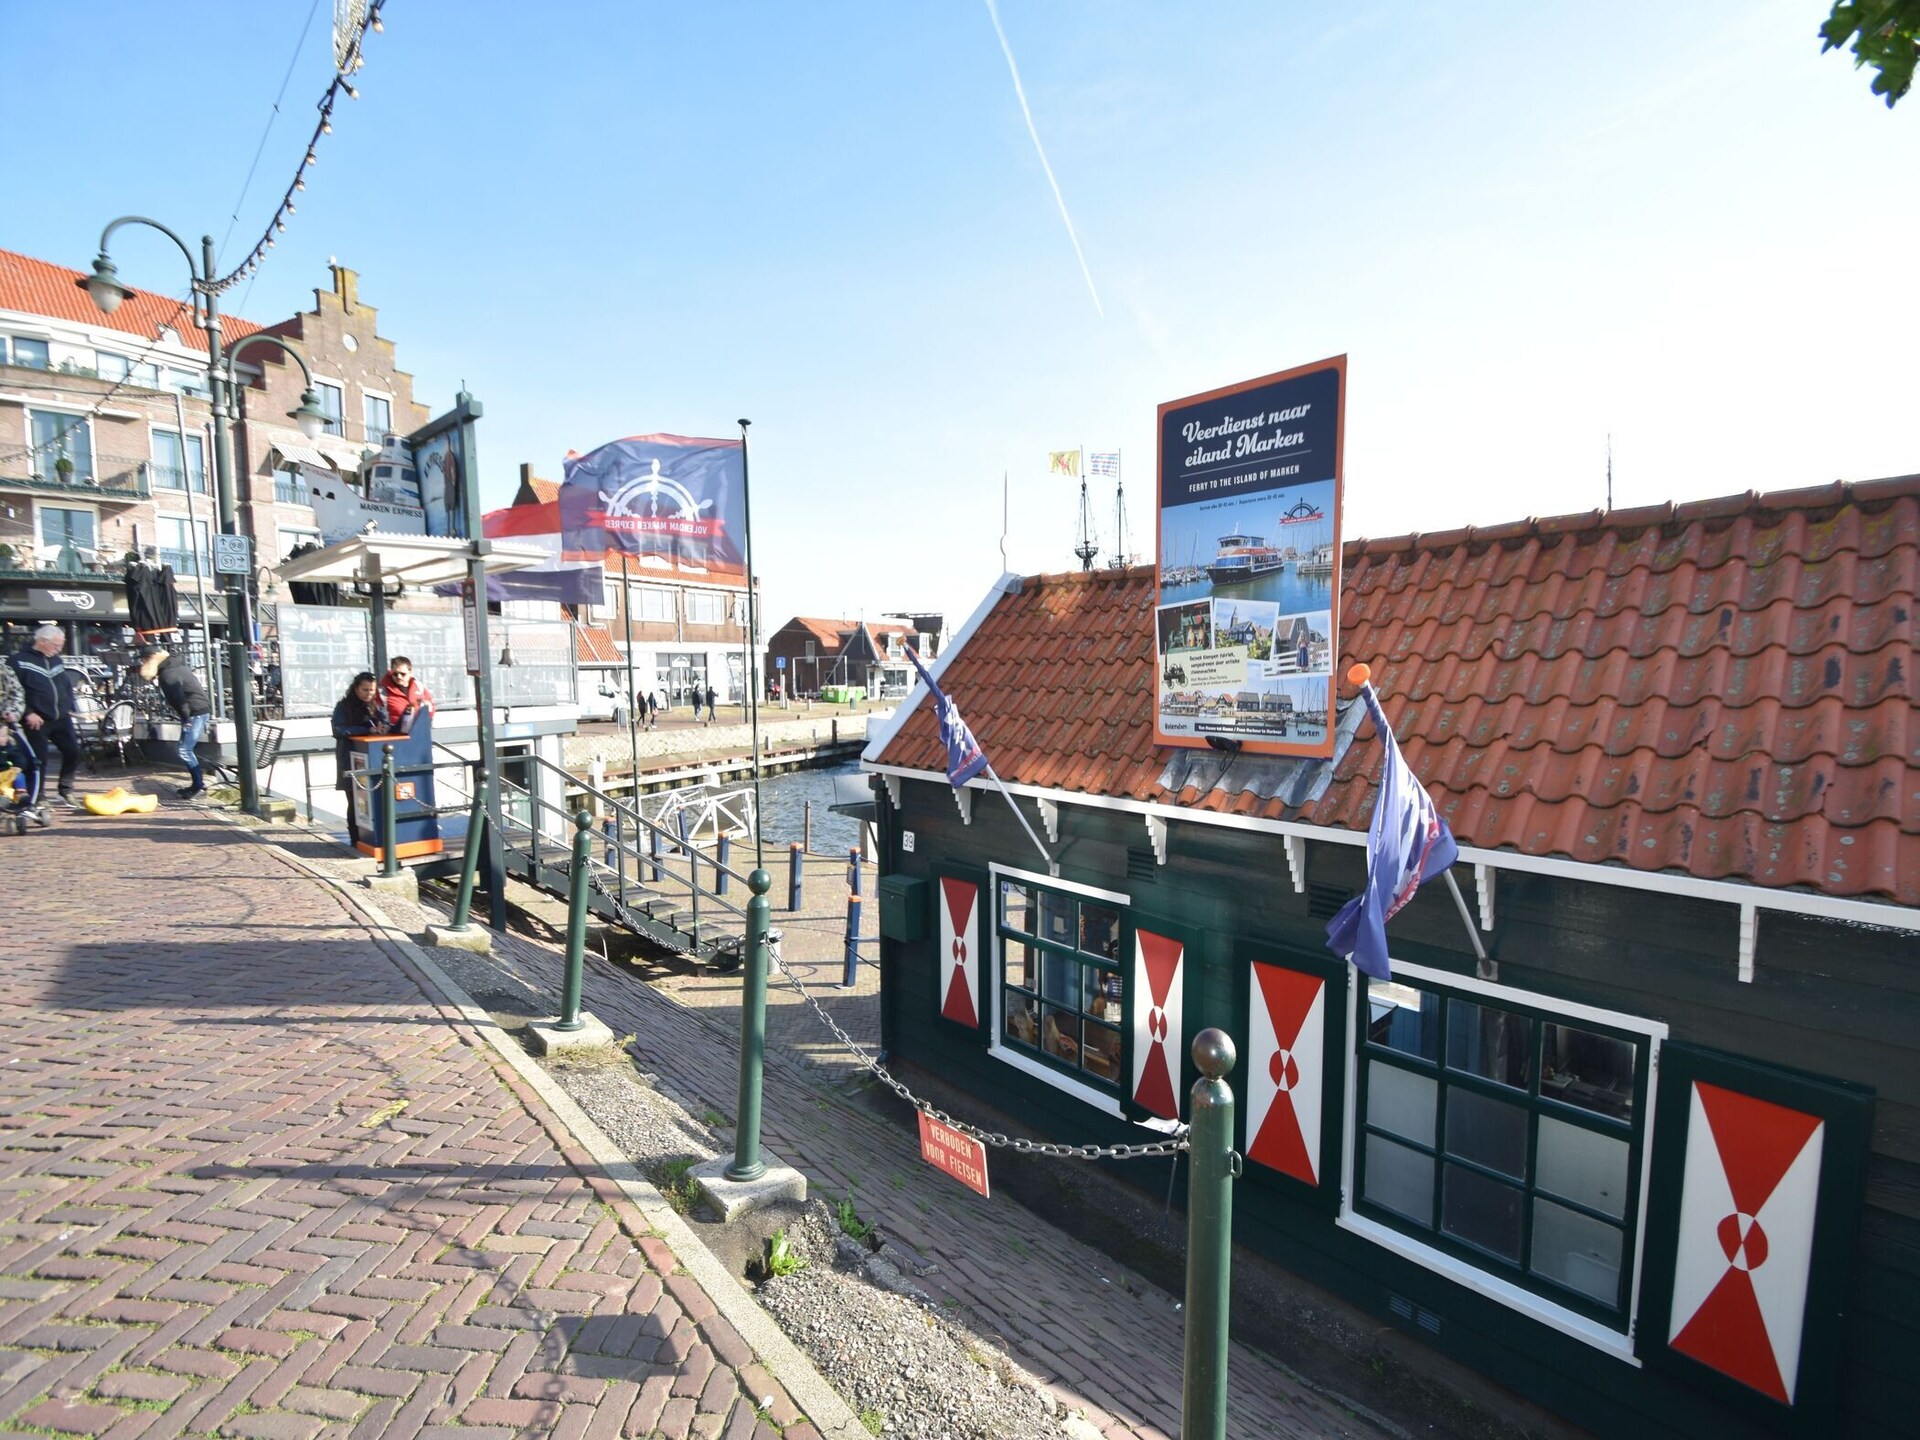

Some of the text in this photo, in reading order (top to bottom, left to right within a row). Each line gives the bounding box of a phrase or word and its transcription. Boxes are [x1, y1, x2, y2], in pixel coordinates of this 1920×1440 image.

[1182, 403, 1311, 443] Veerdienst naar
[1185, 429, 1304, 467] eiland Marken
[1189, 464, 1300, 492] FERRY TO THE ISLAND OF MARKEN
[360, 502, 423, 518] MARKEN EXPRESS
[904, 833, 914, 849] 39
[930, 1123, 972, 1160] VERBODEN
[925, 1141, 982, 1187] VOOR FIETSEN
